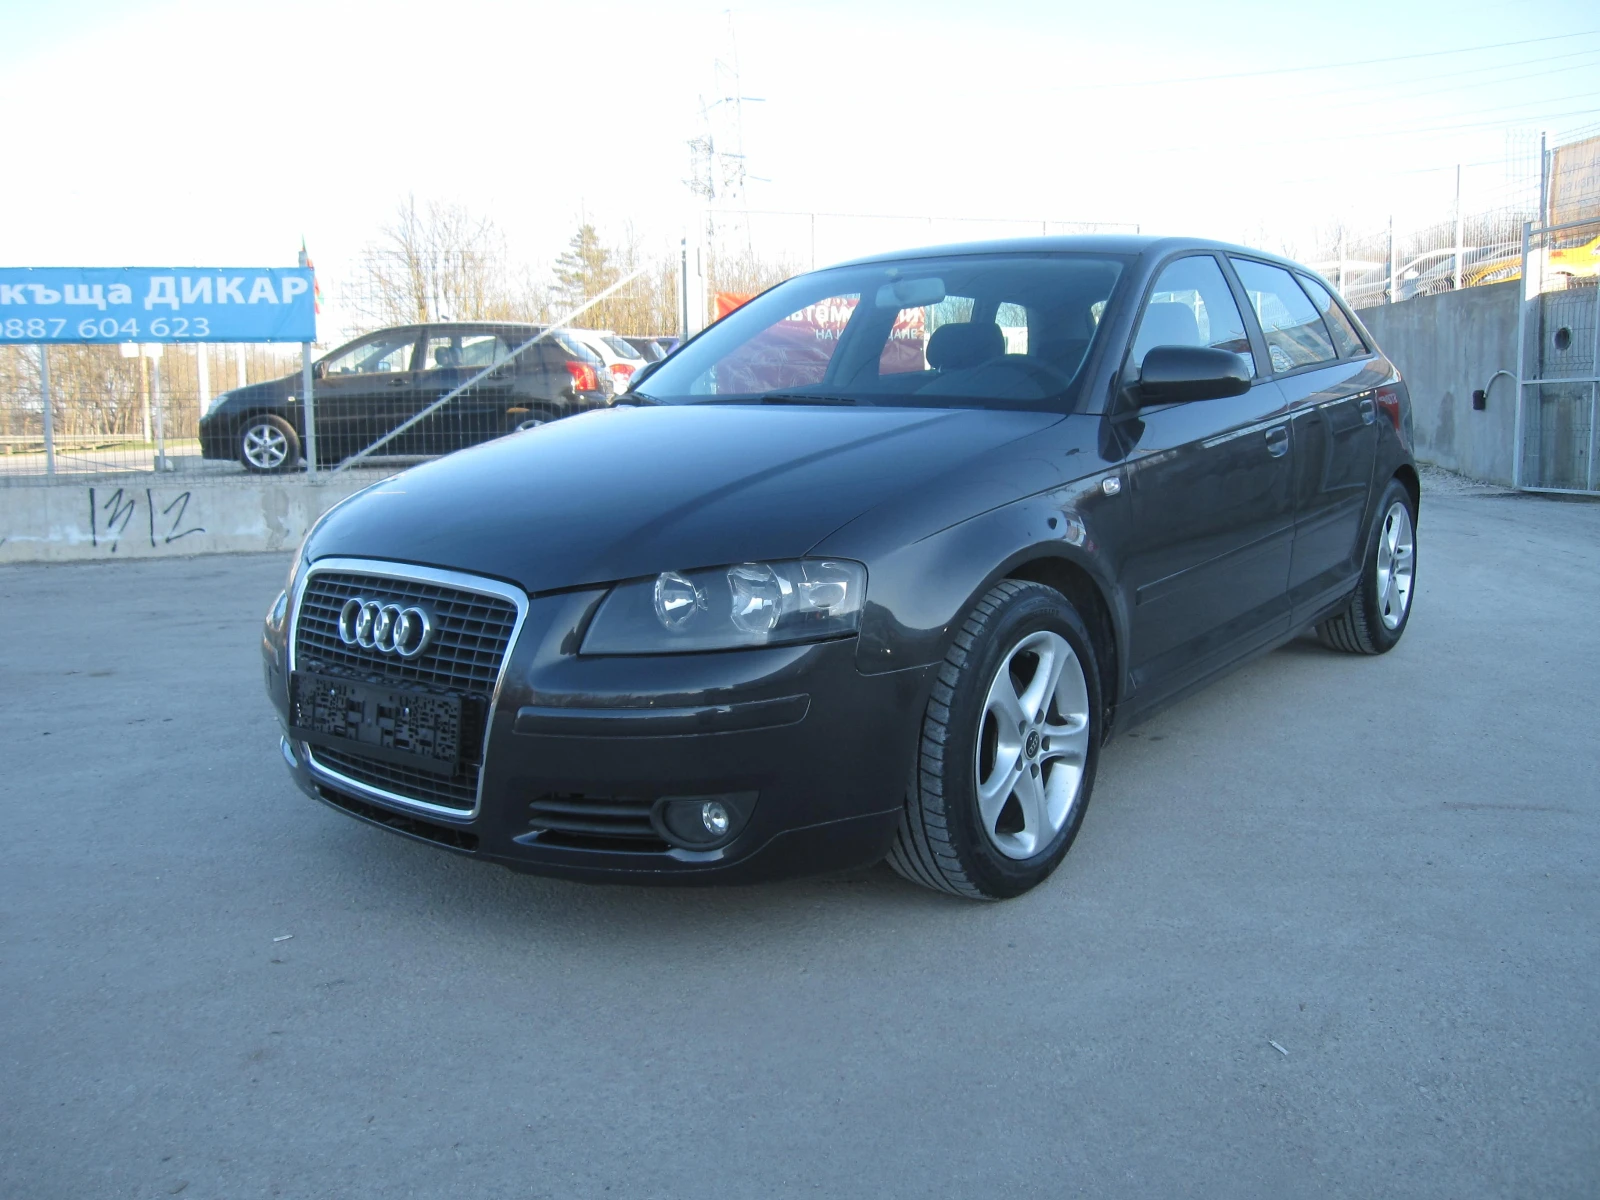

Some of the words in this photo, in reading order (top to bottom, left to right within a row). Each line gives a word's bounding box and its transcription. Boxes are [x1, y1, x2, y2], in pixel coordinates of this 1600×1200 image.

[0, 283, 132, 310] къща
[144, 276, 308, 310] ДИКАР
[0, 318, 67, 338] 887
[78, 318, 140, 338] 604
[150, 317, 210, 337] 623
